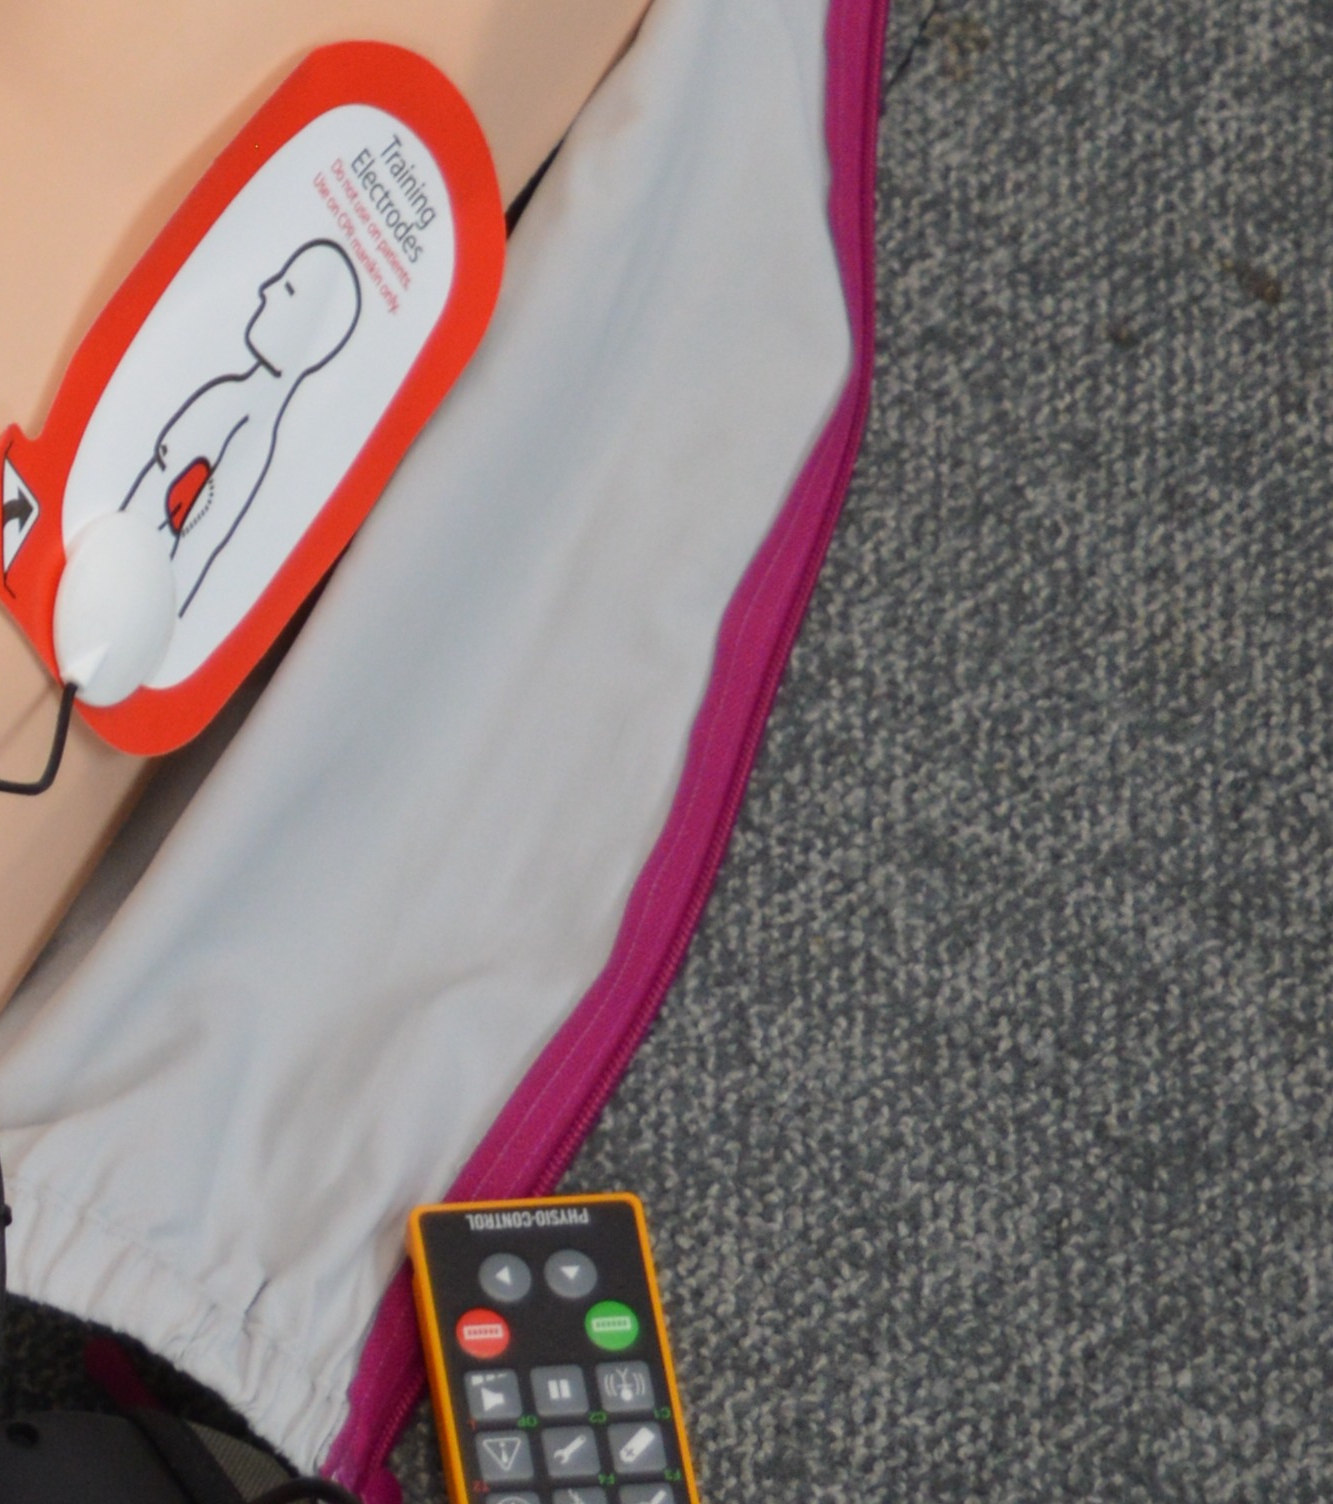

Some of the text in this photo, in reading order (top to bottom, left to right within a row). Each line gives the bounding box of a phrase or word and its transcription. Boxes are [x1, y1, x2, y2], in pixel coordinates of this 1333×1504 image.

[313, 172, 329, 200] Use
[326, 197, 340, 217] on
[337, 212, 355, 239] CPR
[350, 238, 383, 286] manikin
[331, 158, 345, 182] Do
[342, 179, 358, 204] not
[353, 201, 371, 224] use
[367, 222, 381, 240] on
[351, 148, 423, 263] Electrodes
[381, 134, 436, 230] Training
[465, 1208, 590, 1230] PHYSIO-CONTROL
